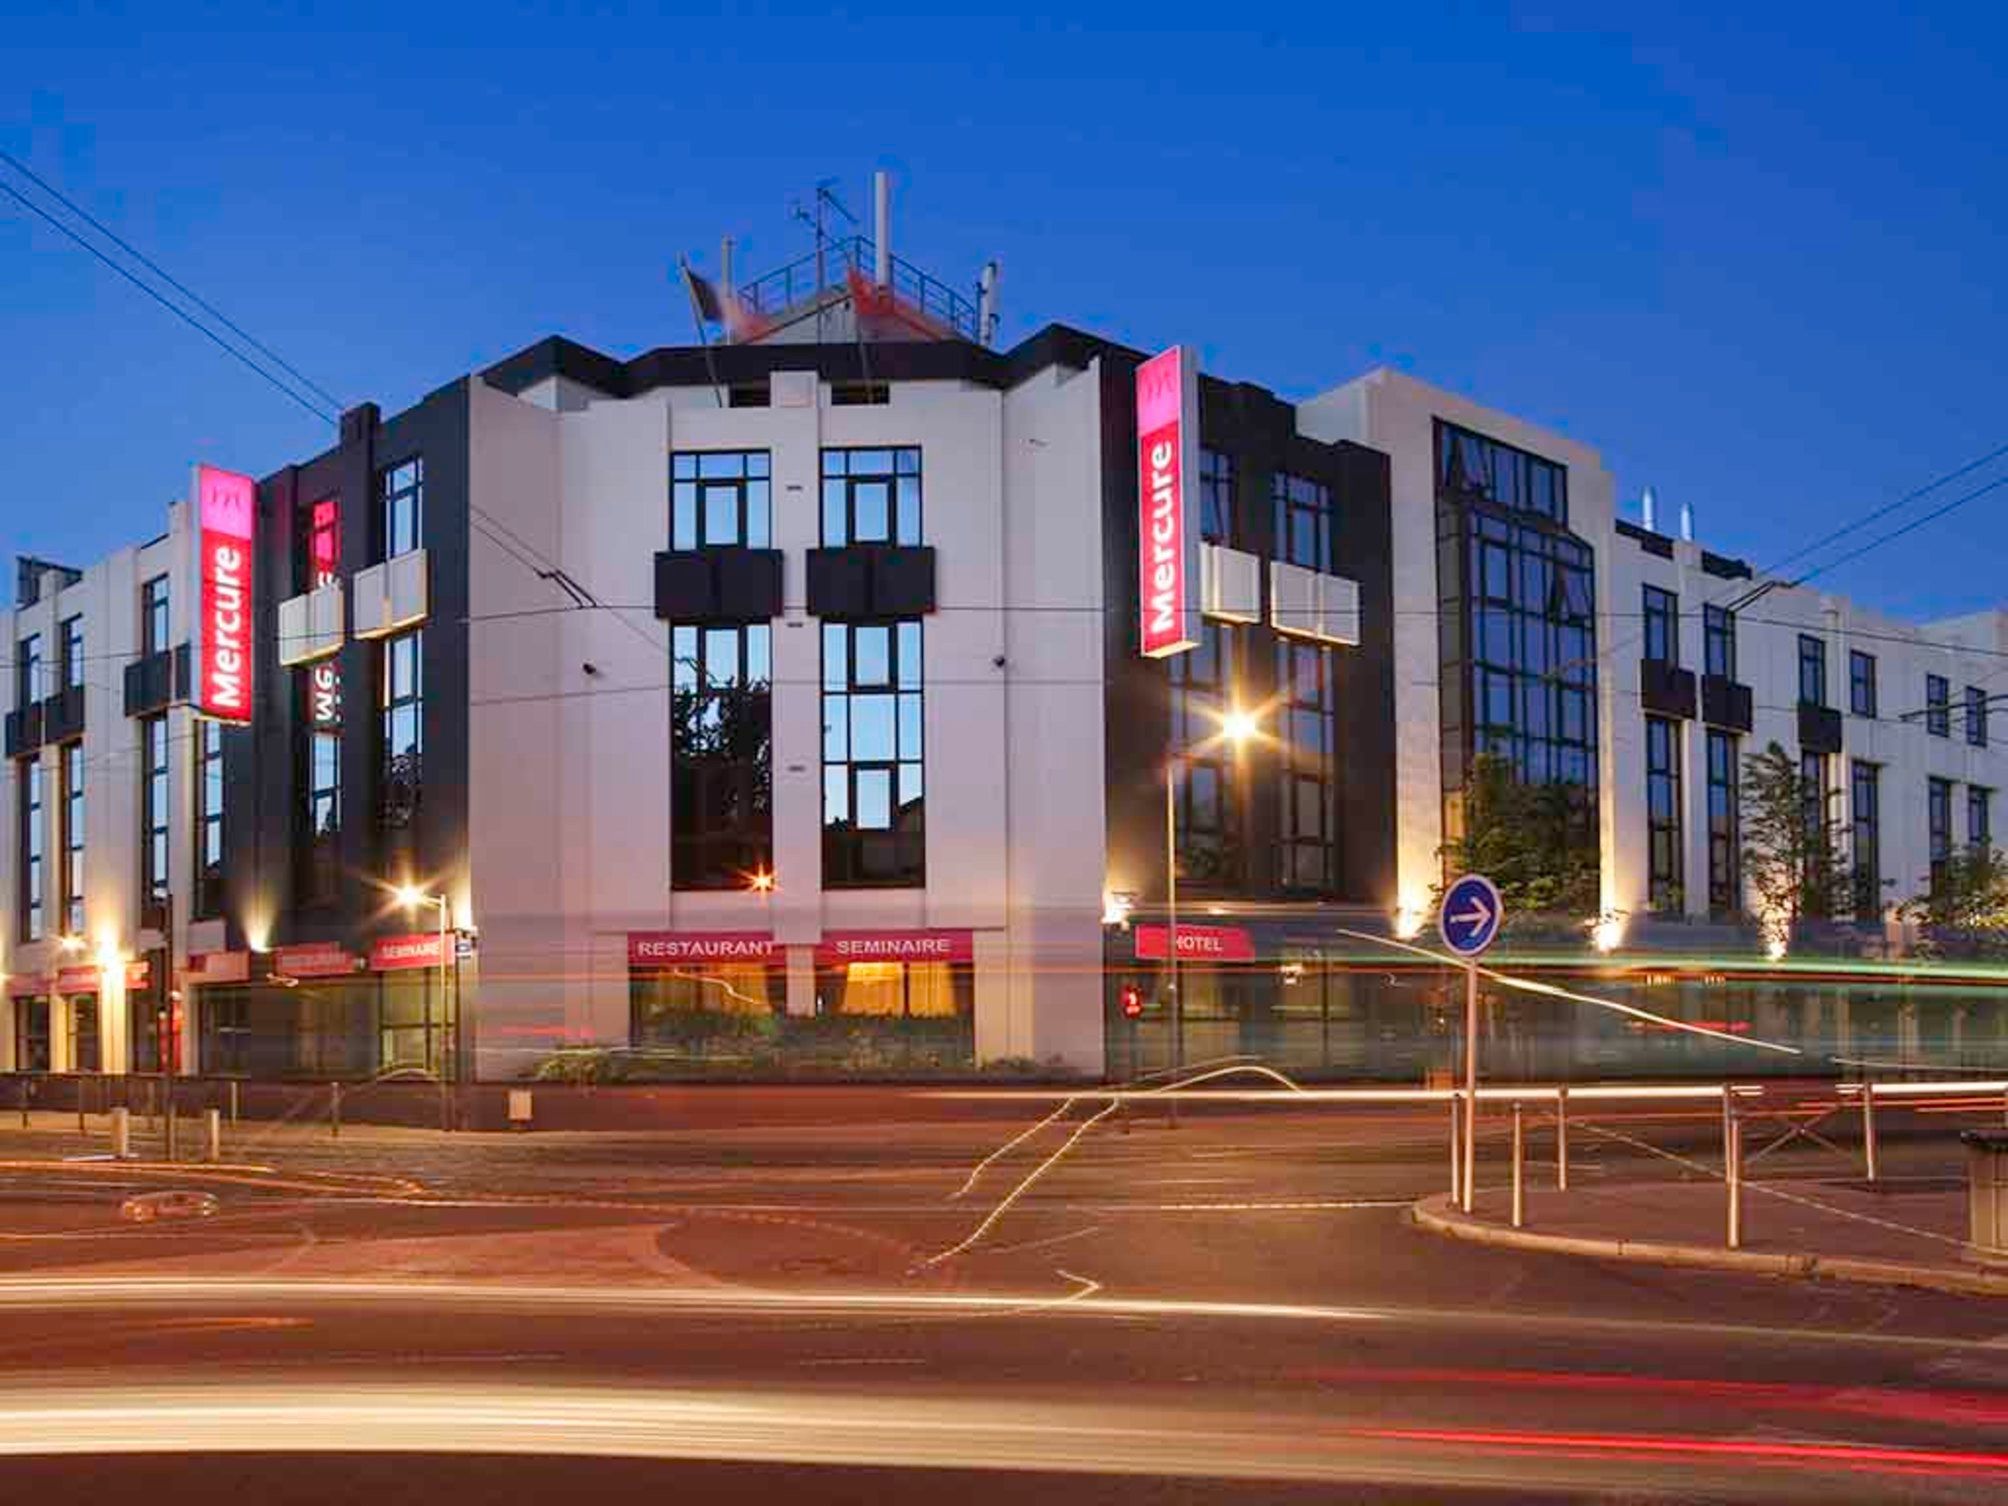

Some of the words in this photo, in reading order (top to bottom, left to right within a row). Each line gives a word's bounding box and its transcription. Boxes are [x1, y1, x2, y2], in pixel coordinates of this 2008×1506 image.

[1151, 440, 1175, 634] Mercure
[211, 546, 242, 707] Mercure
[637, 940, 775, 956] RESTAURANT
[836, 938, 951, 954] SEMINAIRE
